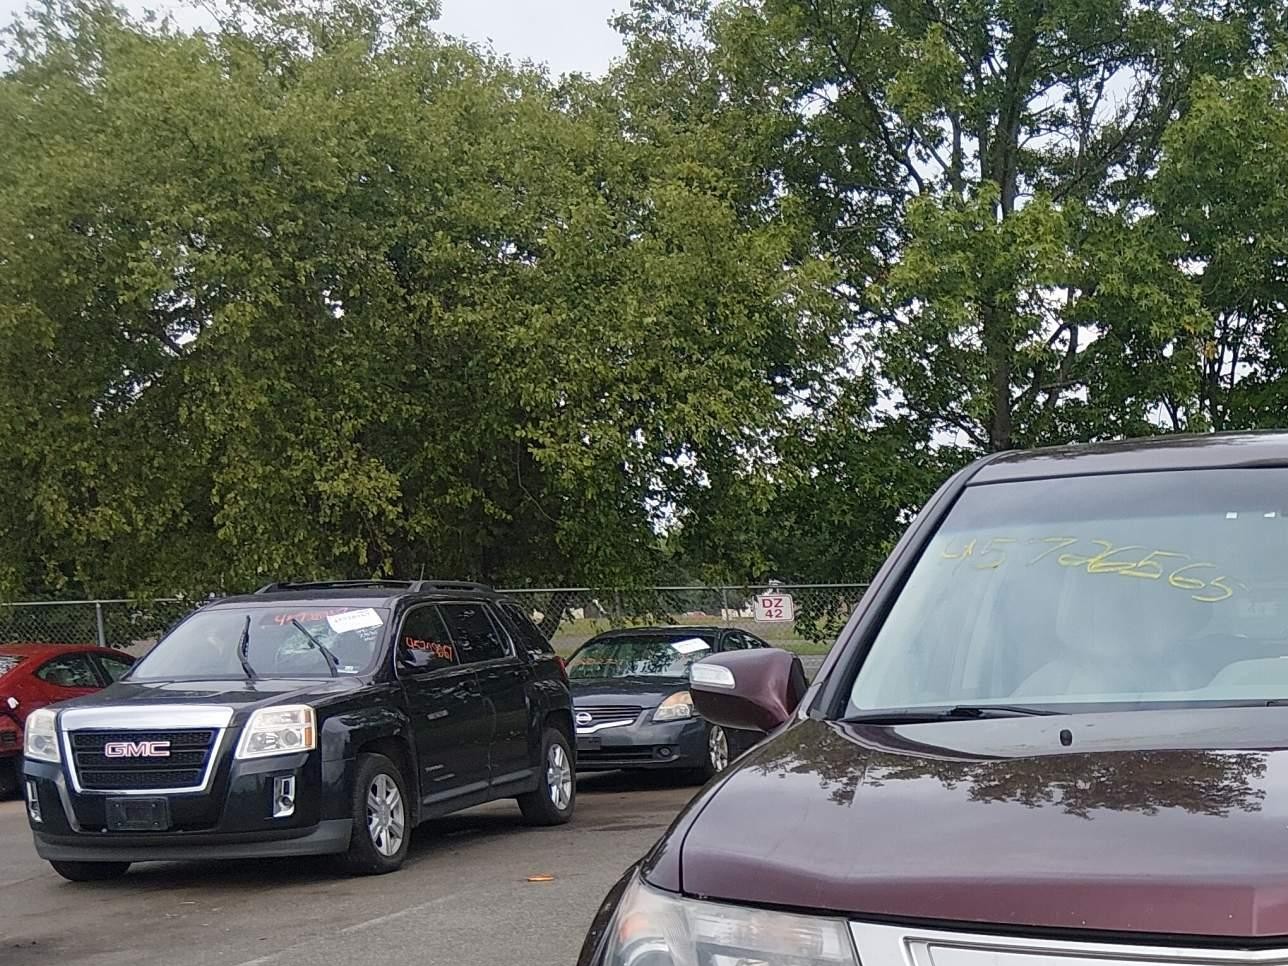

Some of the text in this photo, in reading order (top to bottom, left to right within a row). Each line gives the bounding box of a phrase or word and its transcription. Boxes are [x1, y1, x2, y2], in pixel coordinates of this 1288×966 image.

[762, 598, 784, 608] DZ
[765, 609, 783, 618] 42
[105, 741, 171, 758] GMC
